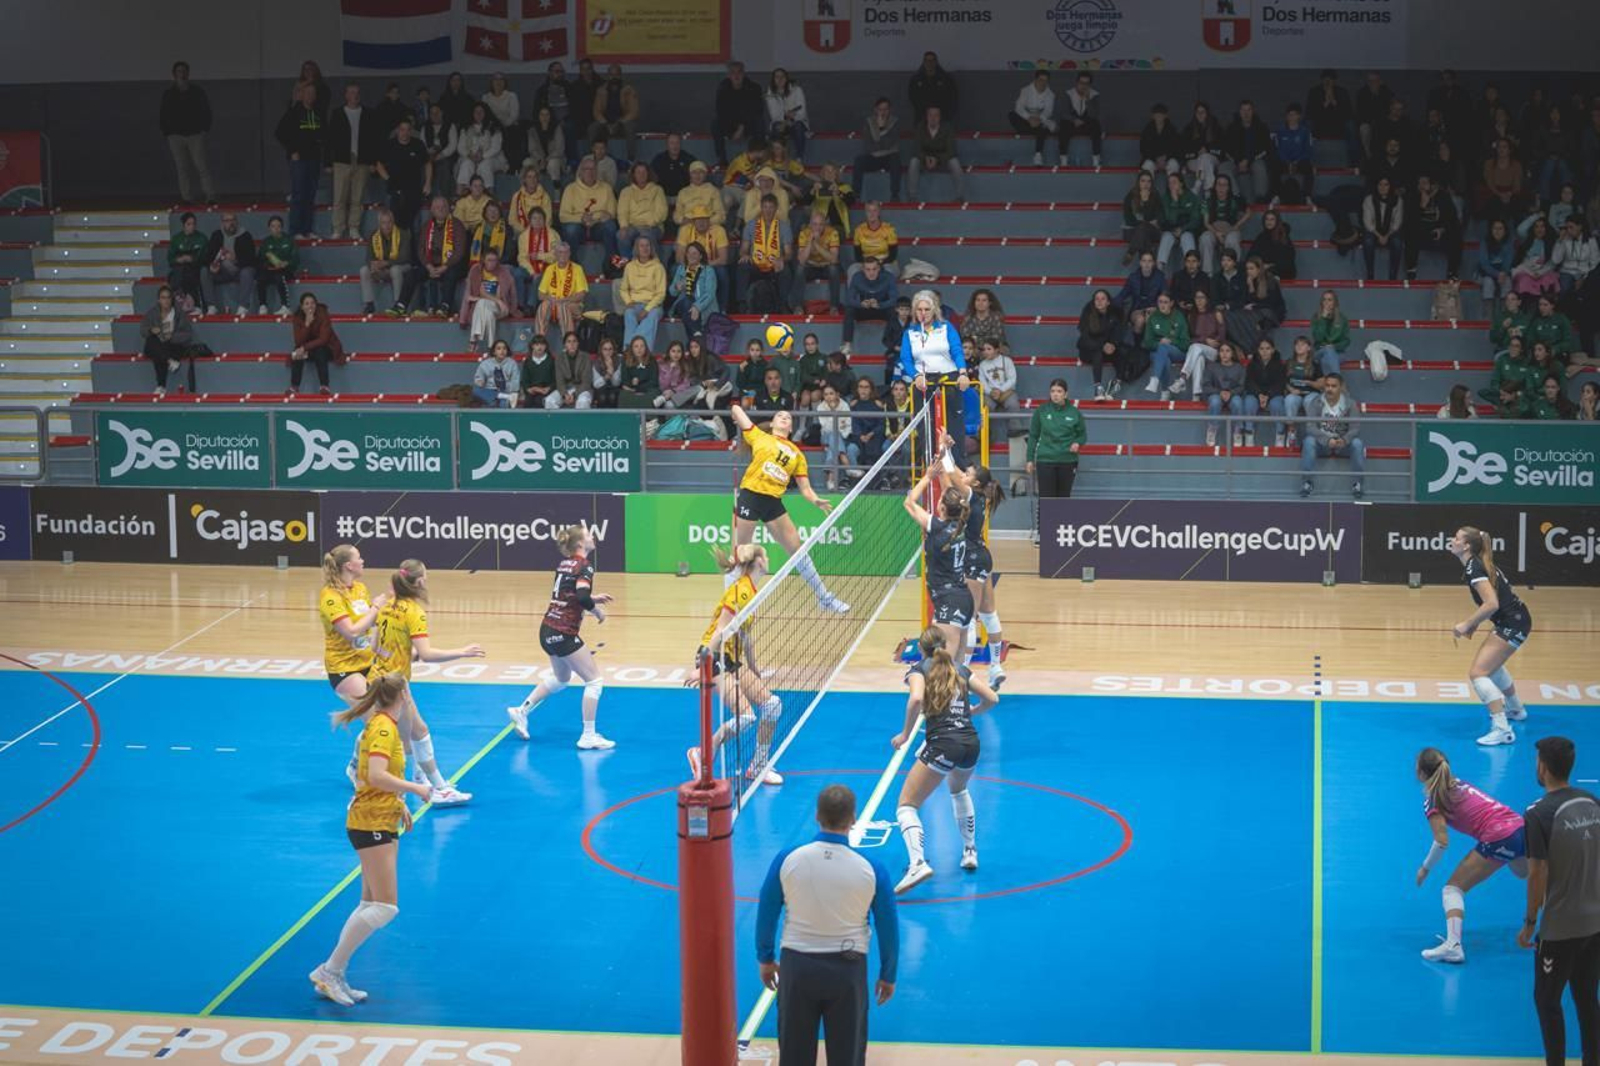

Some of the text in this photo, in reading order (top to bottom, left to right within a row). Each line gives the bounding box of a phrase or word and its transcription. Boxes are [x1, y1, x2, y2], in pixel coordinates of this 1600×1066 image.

[864, 8, 992, 23] Dos Hermanas
[1262, 6, 1392, 23] Dos Hermanas
[186, 433, 259, 448] Diputación
[365, 435, 441, 450] Diputación
[551, 435, 629, 450] Diputación
[187, 449, 259, 471] Sevilla
[365, 451, 441, 472] Sevilla
[552, 452, 630, 473] Sevilla
[776, 450, 791, 467] 14
[1514, 447, 1595, 462] Diputación
[1514, 465, 1594, 487] Sevilla
[36, 513, 155, 536] Fundación
[195, 508, 315, 550] Cajasol
[688, 524, 731, 544] DOS
[1056, 523, 1345, 556] #CEVChallengeCupW
[1387, 531, 1506, 552] Fundan
[1092, 676, 1417, 698] DEPORTES
[40, 1021, 523, 1066] DEPORTES
